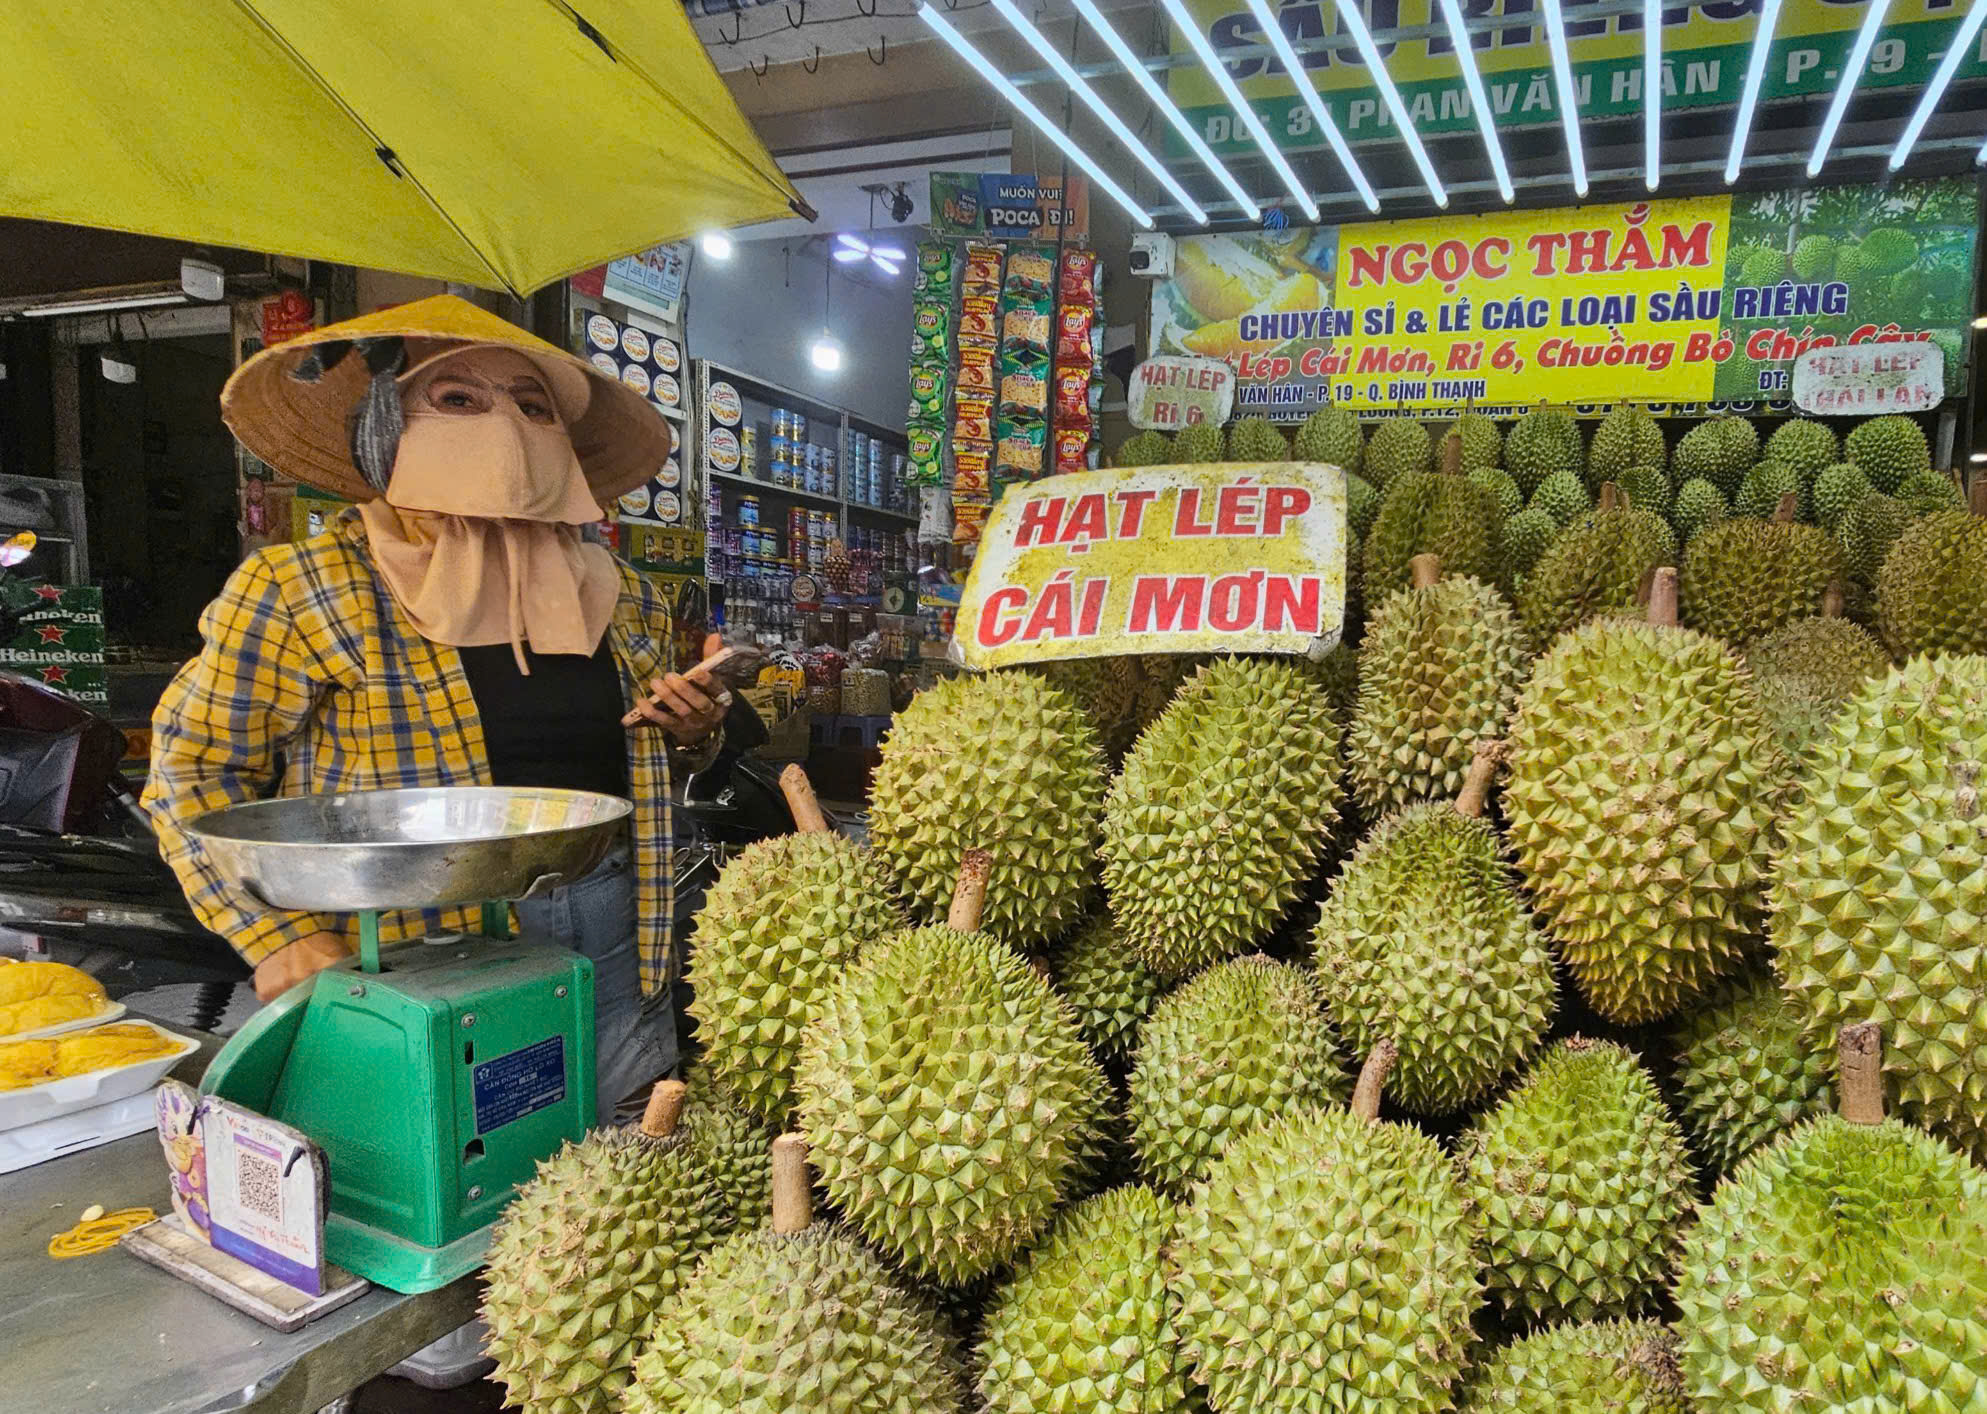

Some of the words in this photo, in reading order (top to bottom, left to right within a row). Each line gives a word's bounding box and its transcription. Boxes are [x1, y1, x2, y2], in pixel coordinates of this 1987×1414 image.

[990, 208, 1041, 225] POCA
[1348, 237, 1511, 294] NGỌC
[1527, 203, 1714, 277] THẮM
[1240, 306, 1353, 342] CHUYÊN
[1363, 301, 1396, 335] SỈ
[1405, 311, 1428, 334] &
[1438, 297, 1471, 332] LẺ
[1481, 296, 1549, 330] CÁC
[1560, 294, 1637, 330] LOẠI
[1648, 281, 1722, 323] SẦU
[1733, 279, 1849, 320] RIÊNG
[1237, 350, 1292, 383] Lép
[1300, 345, 1353, 377] Cái
[1355, 346, 1436, 377] Mơn,
[1446, 340, 1485, 372] Ri
[1490, 340, 1524, 374] 6,
[1536, 329, 1676, 372] Chuồng
[1238, 383, 1268, 405] VĂN
[1271, 381, 1304, 404] HÂN
[1315, 383, 1330, 403] P.
[1334, 384, 1354, 402] 19
[1368, 383, 1383, 403] Q.
[1388, 378, 1429, 401] BÌNH
[1431, 380, 1486, 402] THẠNH
[1758, 369, 1789, 391] ĐT:
[1014, 490, 1157, 553] HẠT
[1174, 476, 1312, 537] LÉP
[977, 570, 1108, 647] CÁI
[1128, 570, 1321, 634] MƠN
[0, 647, 104, 663] Heineken
